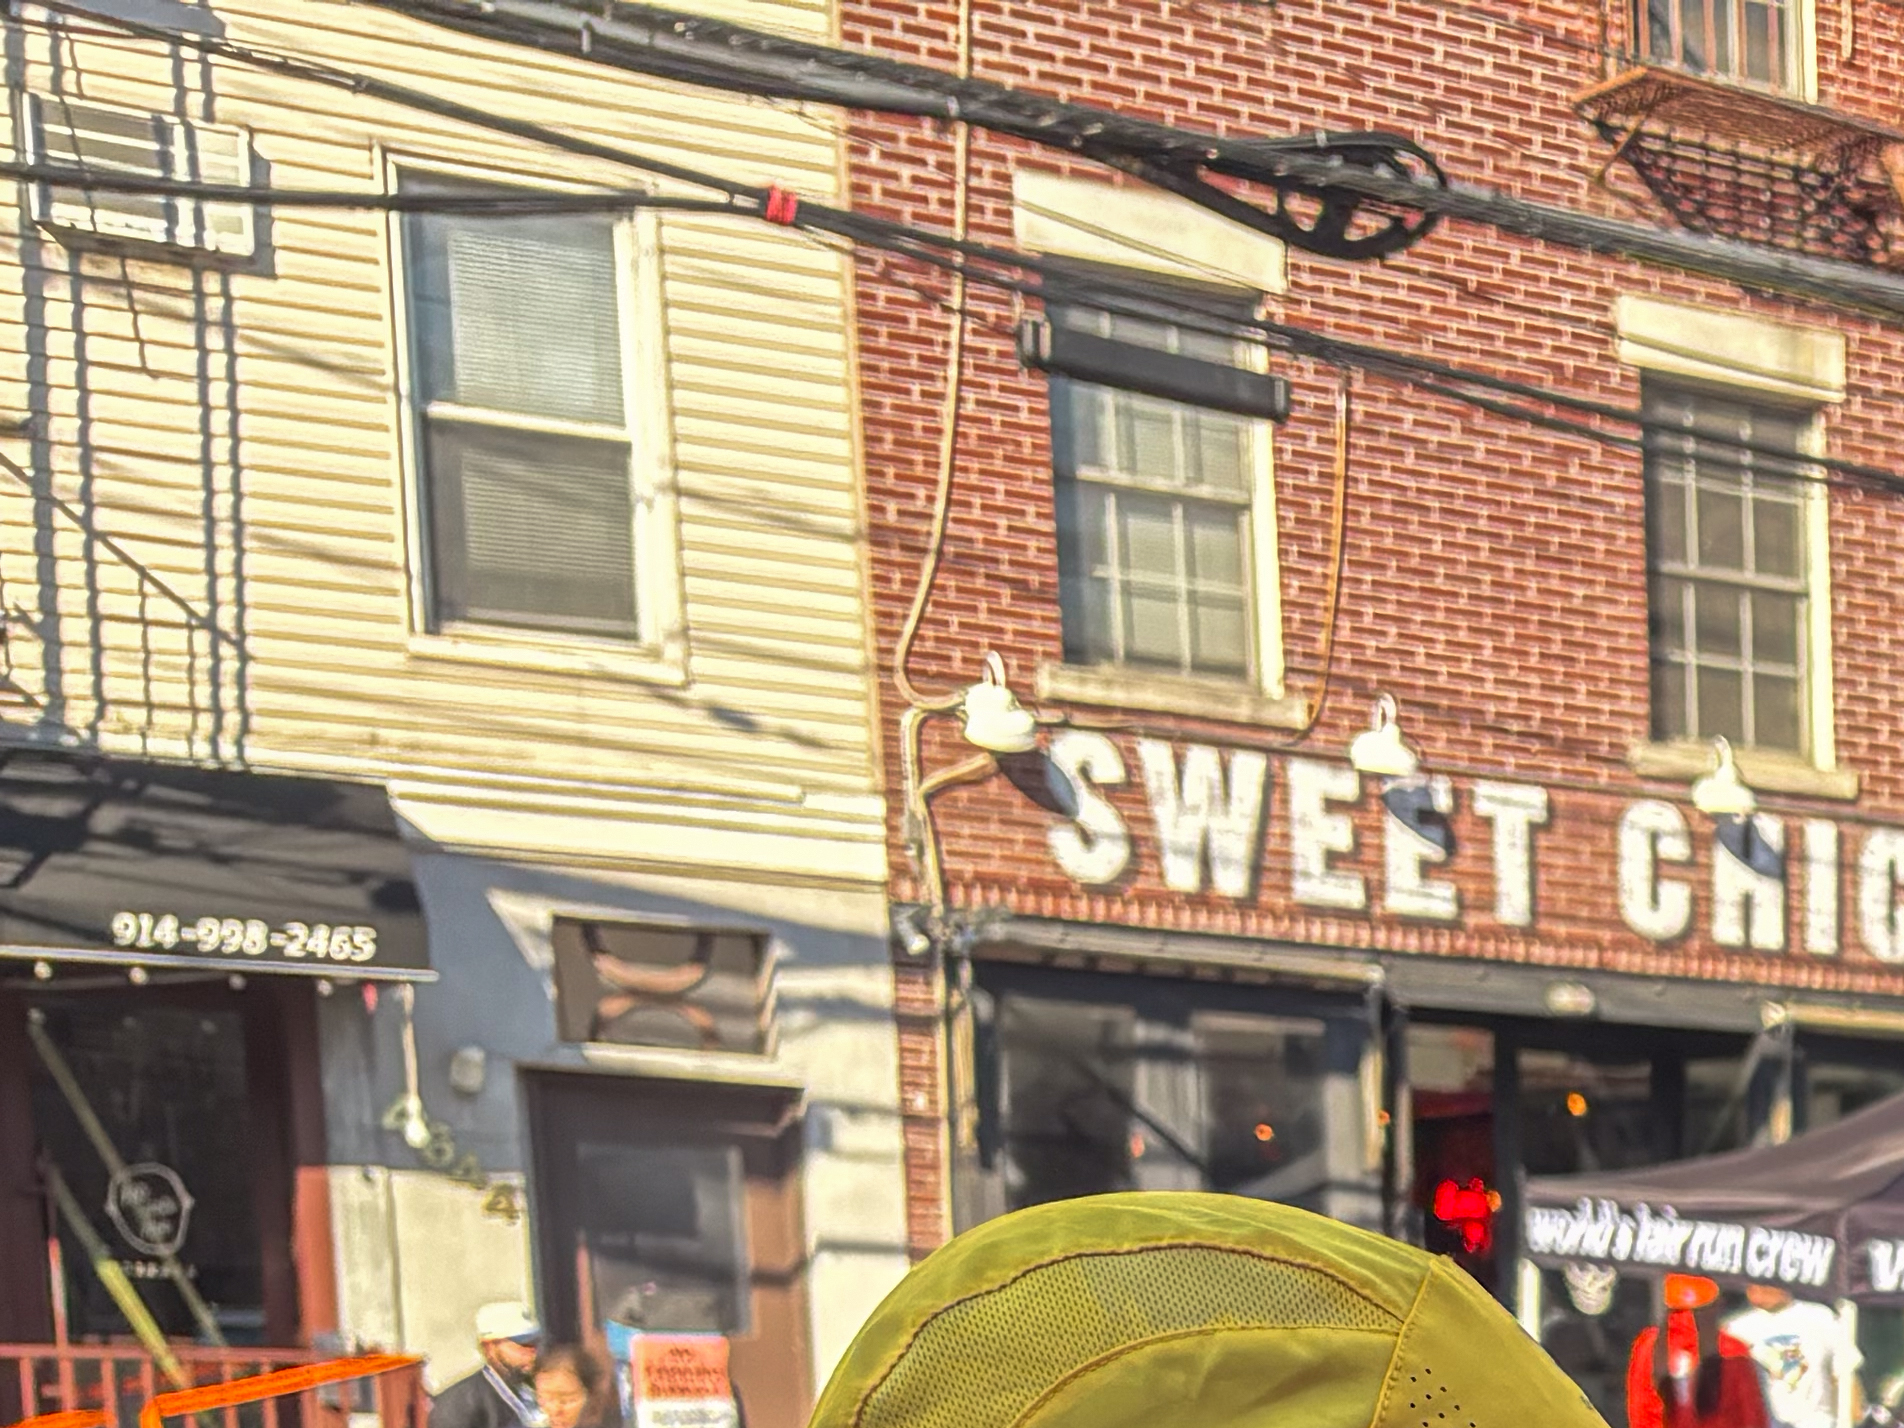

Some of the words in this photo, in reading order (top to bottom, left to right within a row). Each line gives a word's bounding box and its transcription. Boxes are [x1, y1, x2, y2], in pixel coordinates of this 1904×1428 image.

[1049, 730, 1549, 927] SWEET
[111, 911, 377, 962] 914-998-2465
[1746, 1226, 1836, 1286] crew
